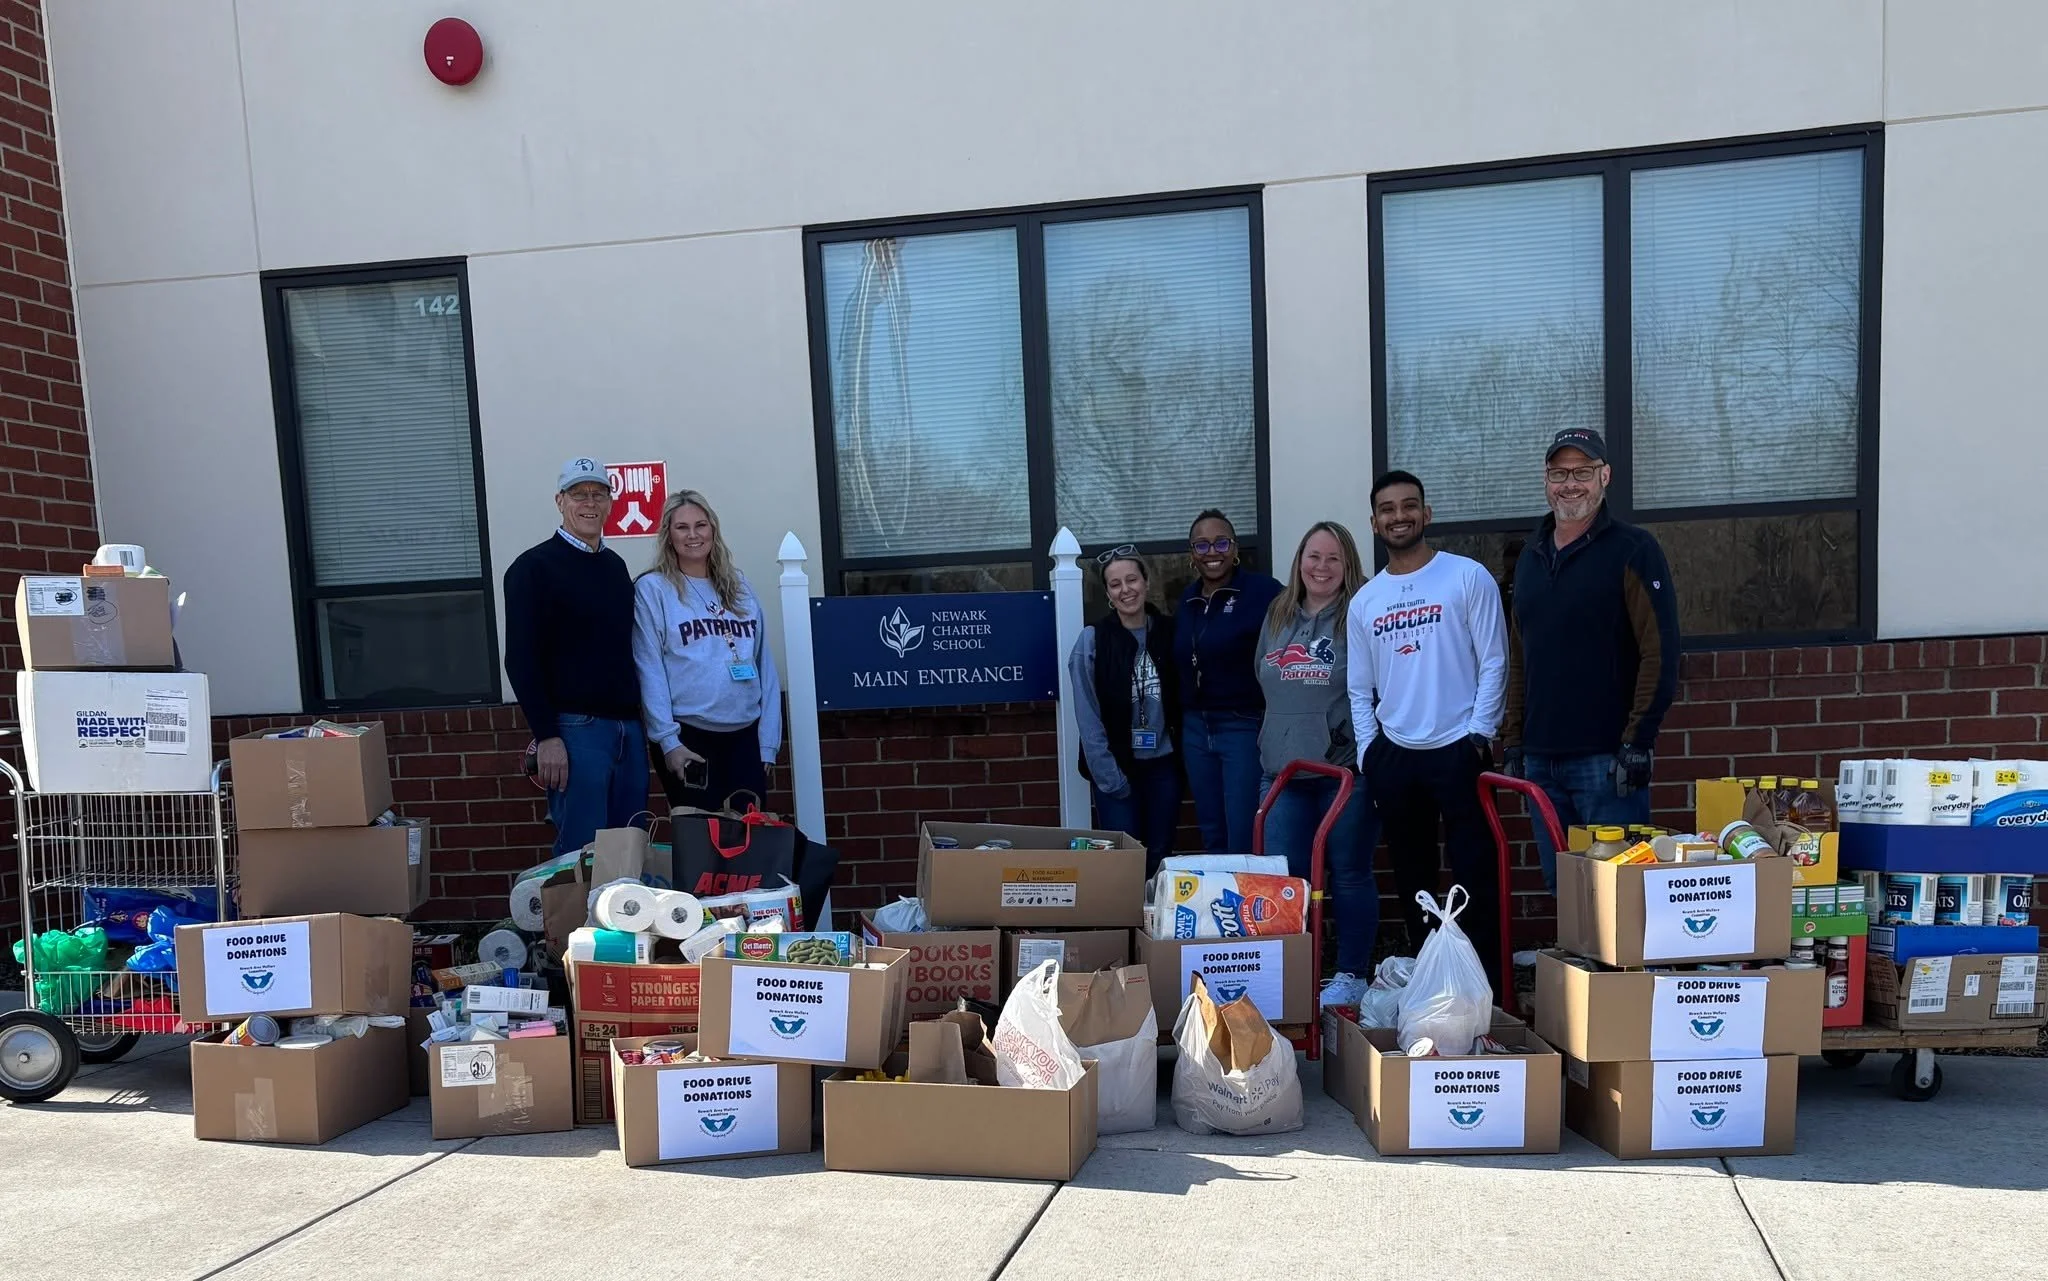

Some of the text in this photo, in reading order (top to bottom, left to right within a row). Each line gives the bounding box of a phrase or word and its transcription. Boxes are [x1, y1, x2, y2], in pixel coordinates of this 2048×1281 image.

[414, 294, 459, 317] 142
[932, 610, 987, 622] NEWARK
[1373, 604, 1442, 636] SOCCER
[932, 624, 991, 636] CHARTER
[933, 638, 986, 650] SCHOOL
[853, 666, 1024, 688] MAIN ENTRANCE
[1282, 670, 1330, 680] Patriots
[77, 718, 115, 726] MADE
[1932, 801, 1970, 812] everyday
[1998, 810, 2048, 826] everyd
[692, 872, 762, 895] ACME
[1179, 880, 1193, 896] $5
[1668, 876, 1732, 888] FOOD DRIVE
[1670, 890, 1732, 902] DONATIONS
[226, 934, 286, 946] FOOD DRIVE
[838, 935, 846, 944] 12
[227, 947, 287, 960] DONATIONS
[1203, 951, 1260, 962] FOOD DRIVE
[915, 964, 991, 982] BOOKS
[1204, 963, 1260, 974] DONATIONS
[630, 982, 700, 995] STRONGES
[756, 978, 824, 990] FOOD DRIVE
[1678, 980, 1706, 990] FOOD
[632, 996, 664, 1006] PAPER
[756, 992, 823, 1004] DONATIONS
[1677, 994, 1740, 1004] DONATIONS
[602, 1024, 616, 1036] 24
[472, 1060, 486, 1078] 20
[1434, 1070, 1500, 1080] FOOD DRIVE
[1265, 1072, 1280, 1090] Pay
[1678, 1070, 1742, 1081] FOOD DRIVE
[684, 1076, 752, 1088] FOOD DRIVE
[1434, 1084, 1500, 1094] DONATIONS
[1678, 1084, 1742, 1094] DONATIONS
[684, 1090, 752, 1102] DONATIONS
[1212, 1100, 1224, 1112] Pay
